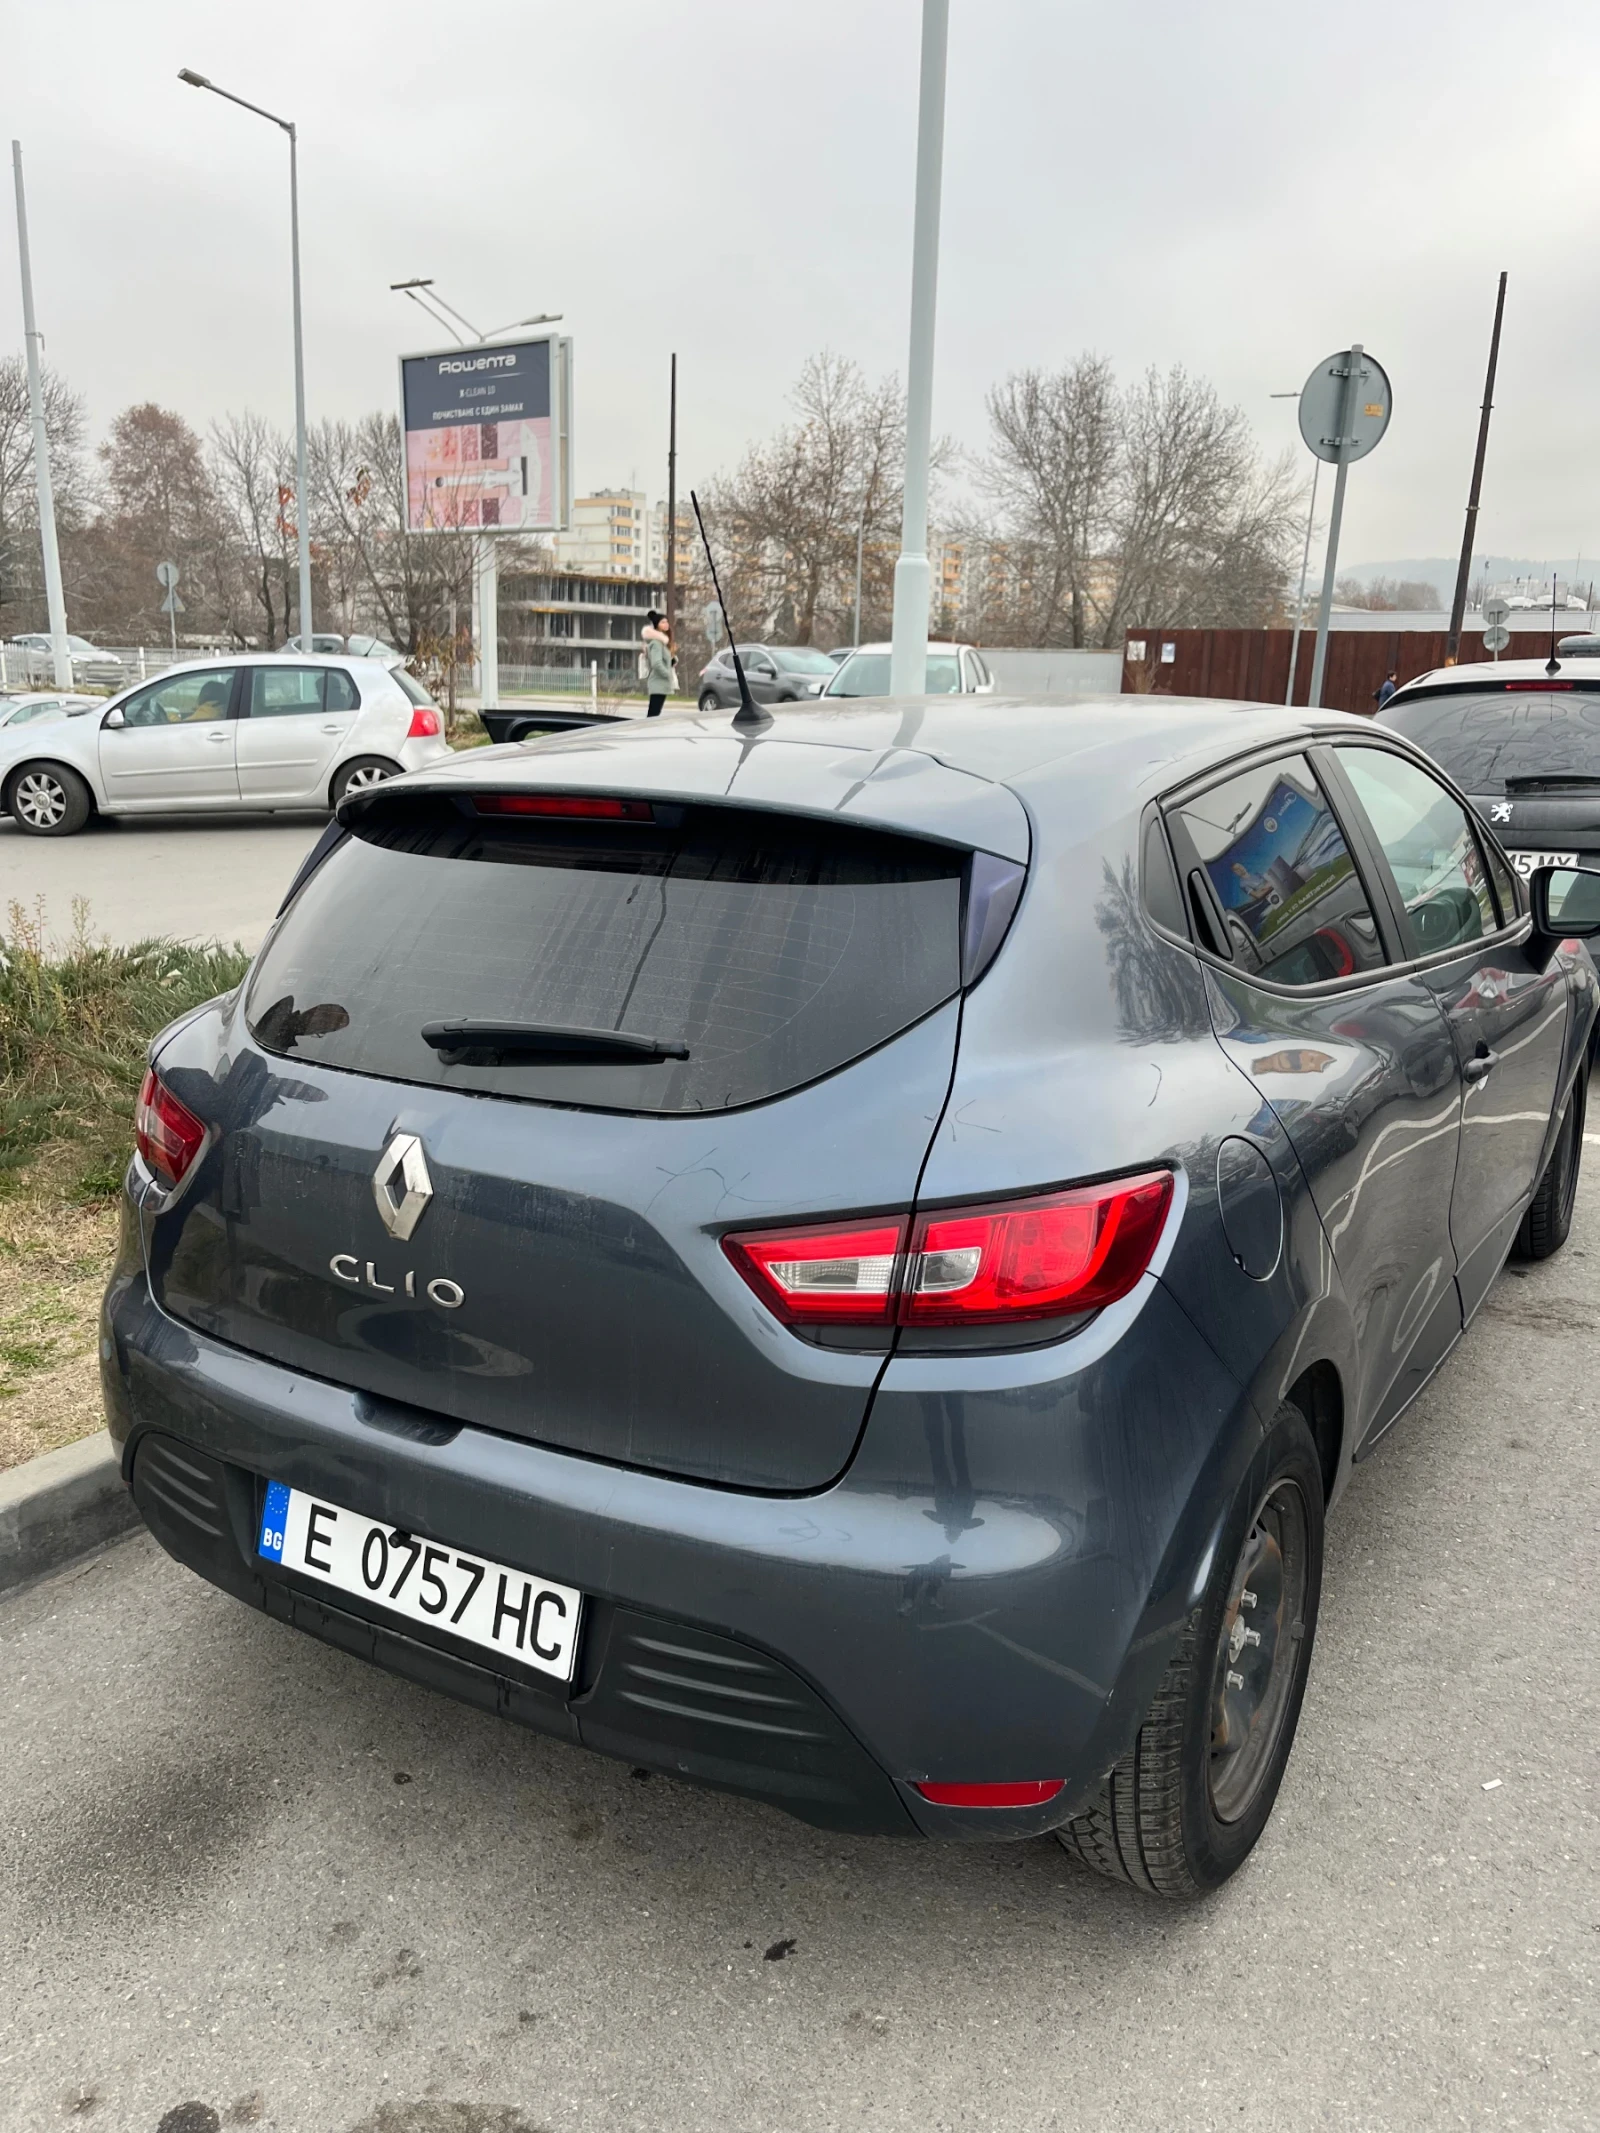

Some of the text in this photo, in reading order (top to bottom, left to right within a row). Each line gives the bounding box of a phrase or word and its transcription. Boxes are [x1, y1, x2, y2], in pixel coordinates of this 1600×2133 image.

[432, 402, 524, 420] ПОЧИСТВАНЕ С ЕДИН ЗАМАХ
[329, 1254, 466, 1309] CLIO
[262, 1527, 283, 1551] BG
[304, 1503, 338, 1573] E
